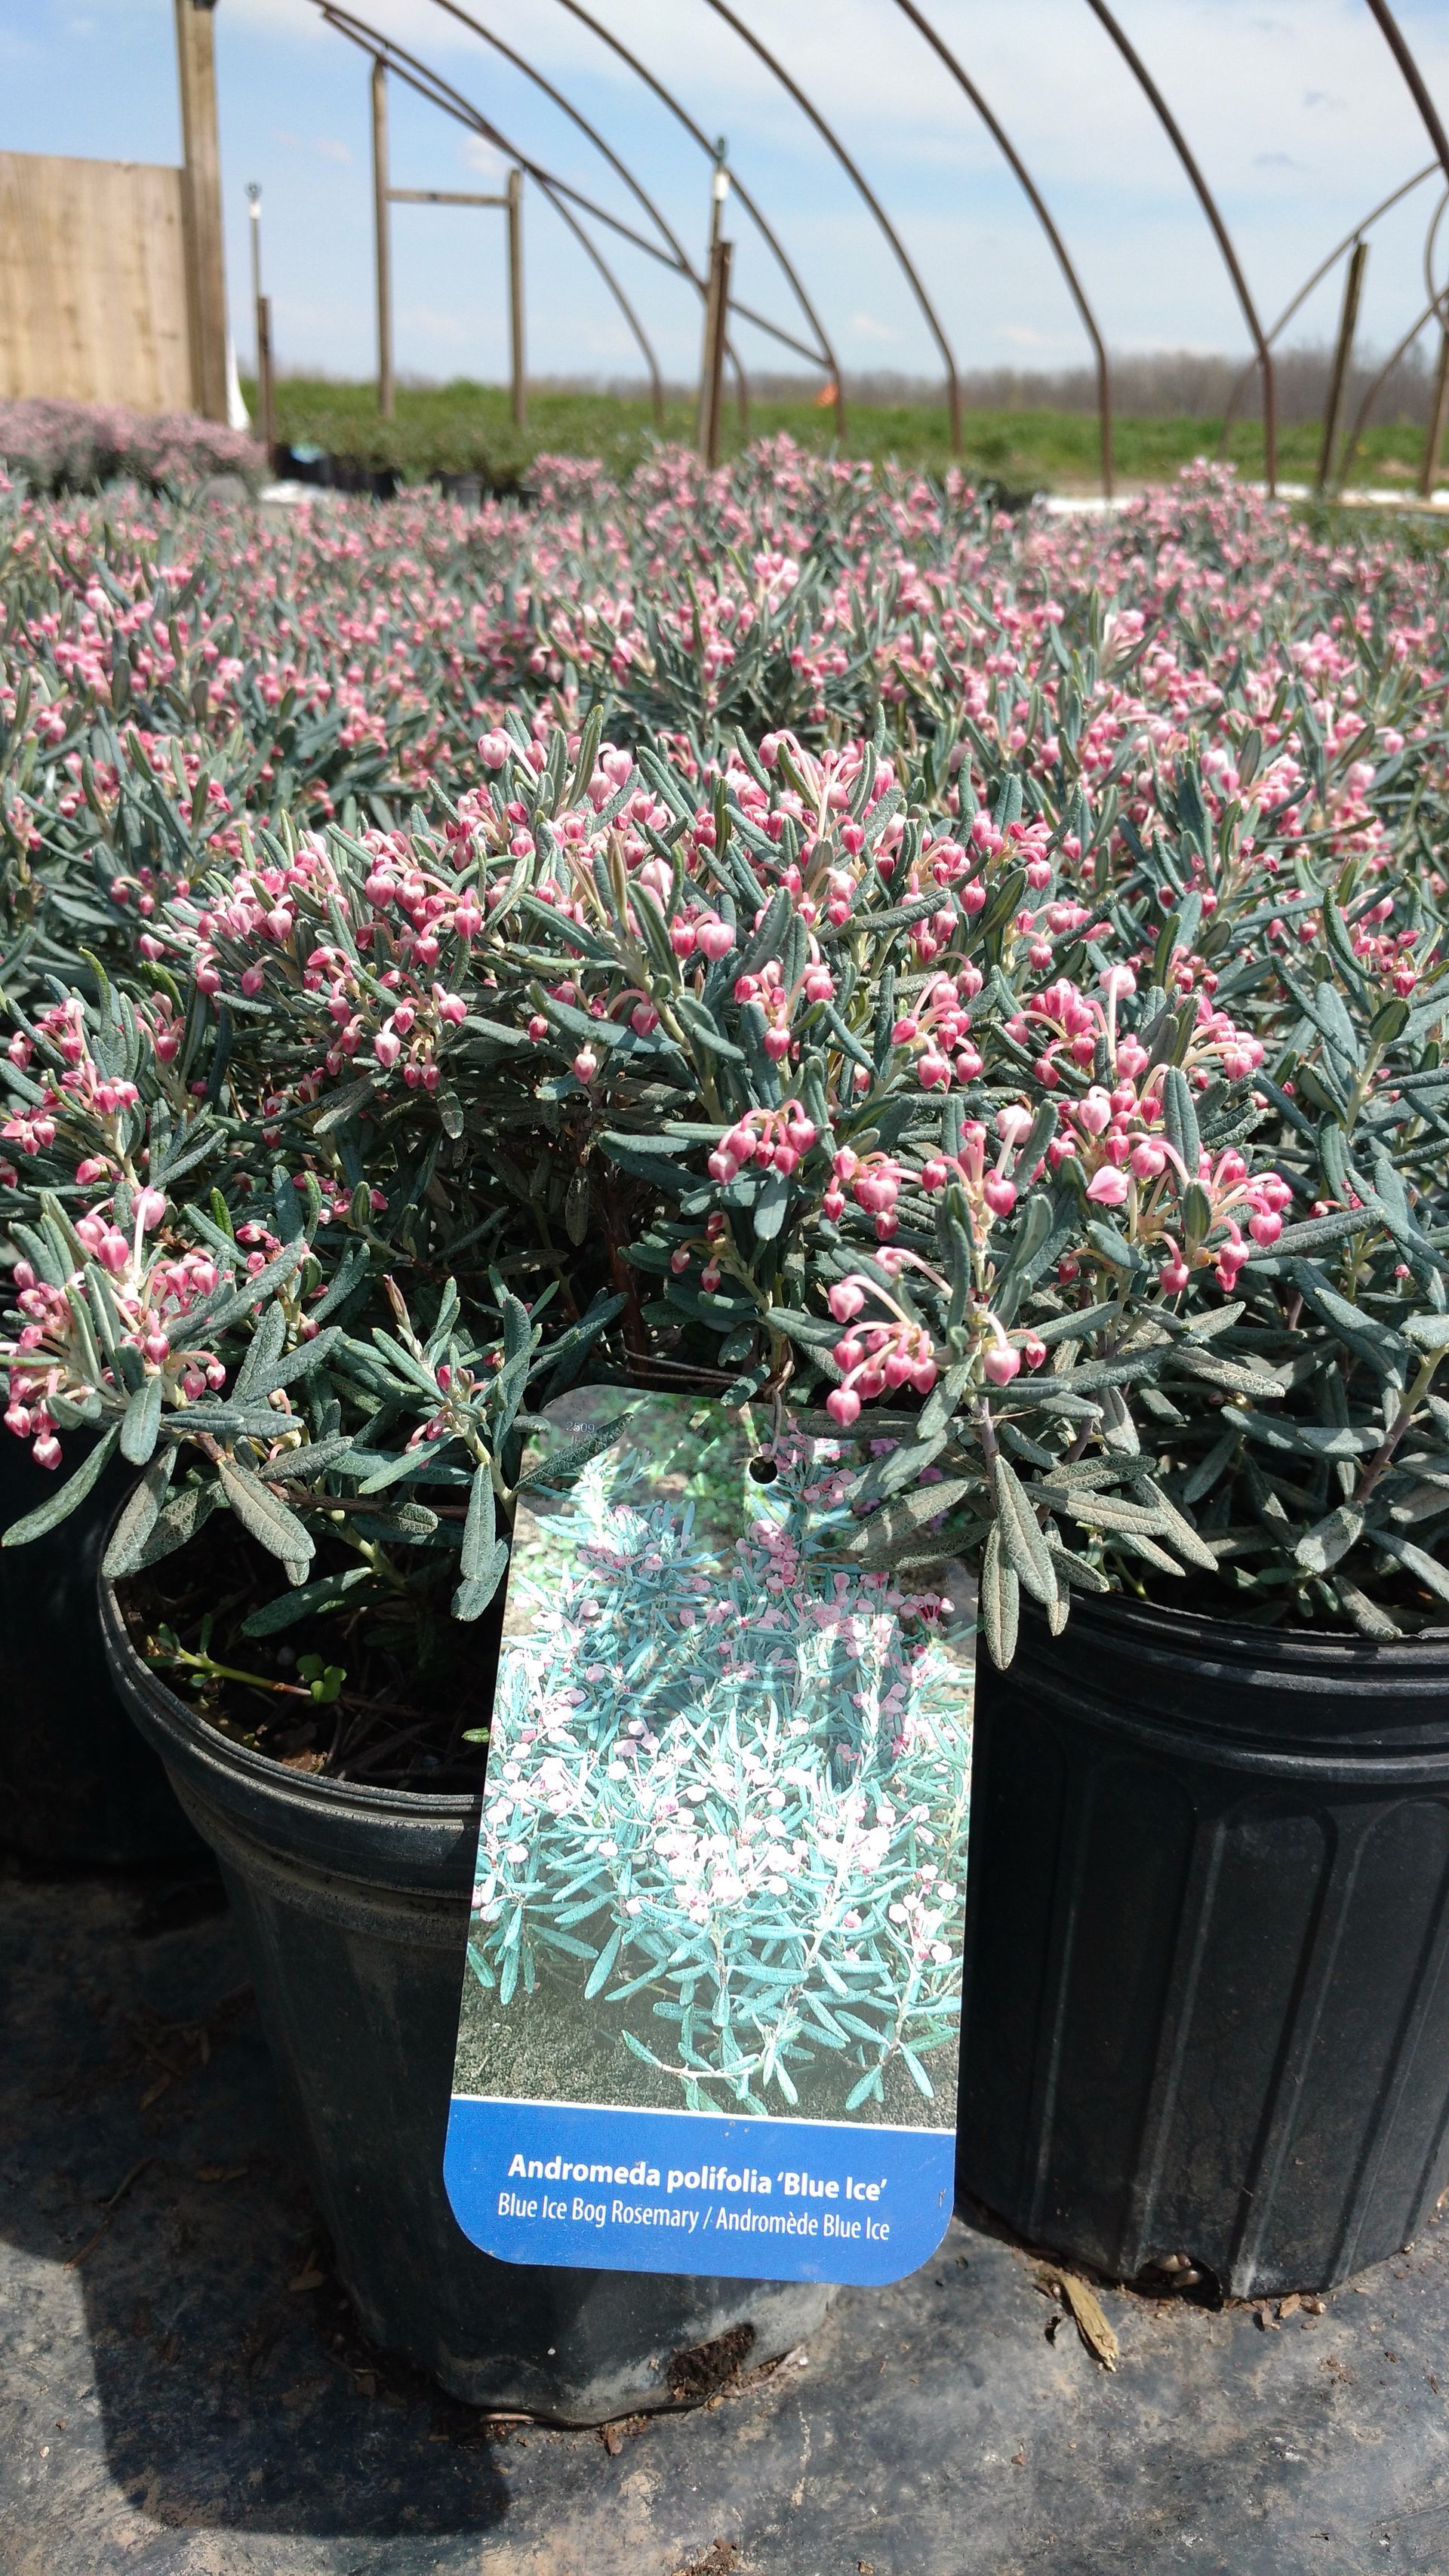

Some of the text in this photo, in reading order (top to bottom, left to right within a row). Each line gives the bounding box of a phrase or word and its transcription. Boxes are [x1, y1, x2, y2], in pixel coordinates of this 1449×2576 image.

[566, 1421, 595, 1433] 2509
[507, 2153, 660, 2187] Andromeda
[666, 2165, 772, 2193] polifolia
[497, 2192, 891, 2241] Blue Ice Bog Rosemary / Andromède Blue Ice
